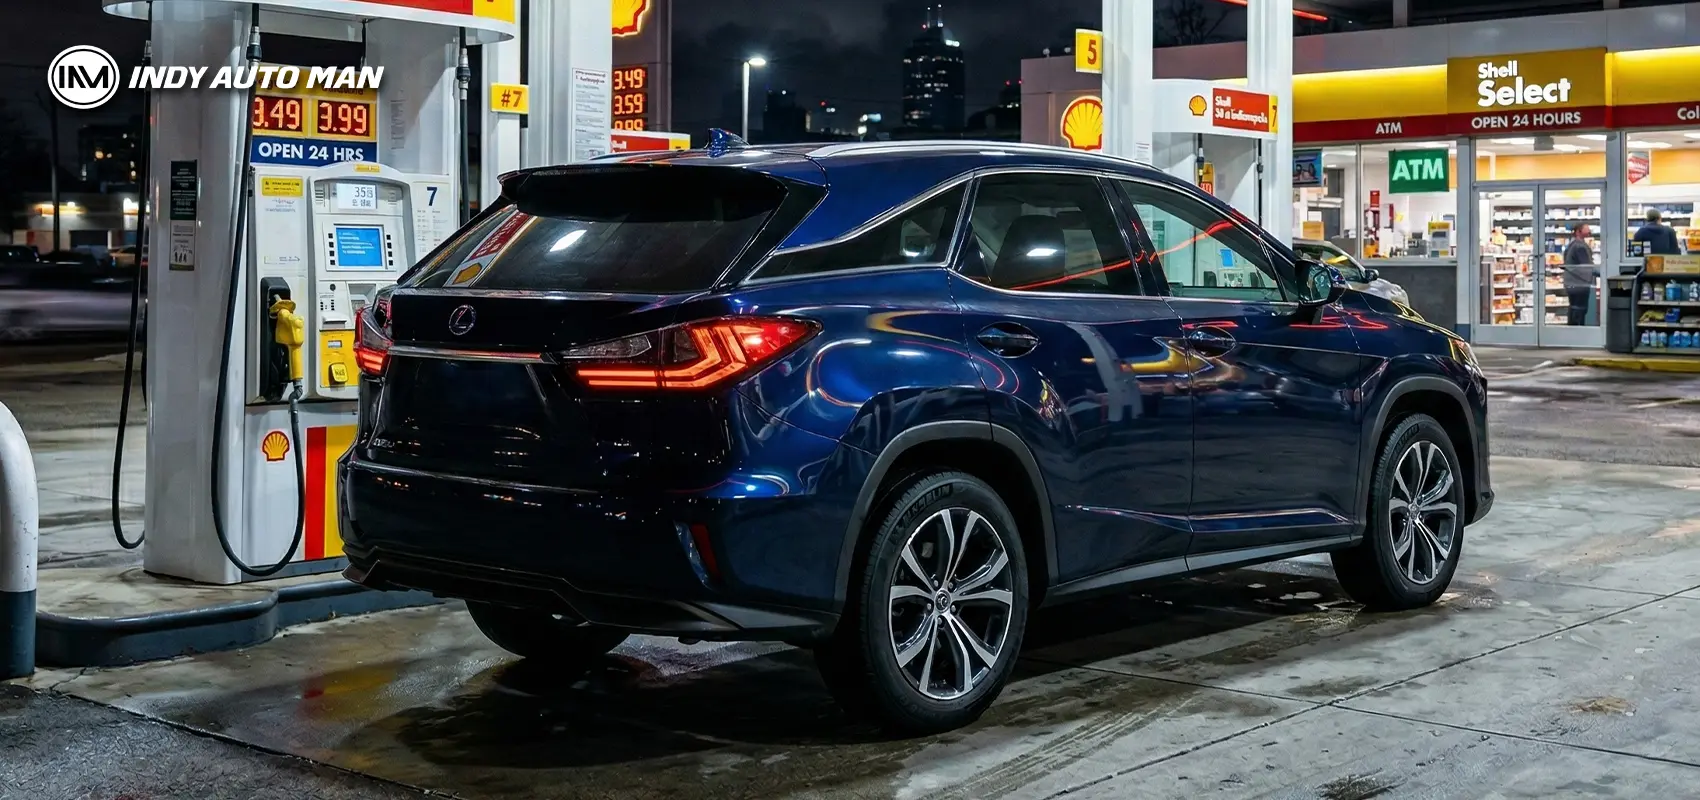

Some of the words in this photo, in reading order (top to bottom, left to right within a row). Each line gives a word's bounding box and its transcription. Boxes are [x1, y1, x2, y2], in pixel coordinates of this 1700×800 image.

[1086, 39, 1098, 65] 5
[614, 68, 643, 90] 3.49
[1477, 60, 1518, 80] Shell
[501, 89, 523, 107] #7
[1477, 76, 1572, 107] Select
[614, 93, 643, 115] 3.59
[252, 96, 300, 130] 3.49
[318, 102, 367, 134] 3.99
[1471, 115, 1508, 130] OPEN
[1512, 114, 1530, 127] 24
[1533, 111, 1582, 126] HOURS
[1375, 122, 1402, 134] ATM
[258, 142, 304, 159] OPEN
[308, 145, 329, 161] 24
[333, 147, 364, 162] HRS
[1392, 158, 1444, 181] ATM
[426, 186, 438, 207] 7
